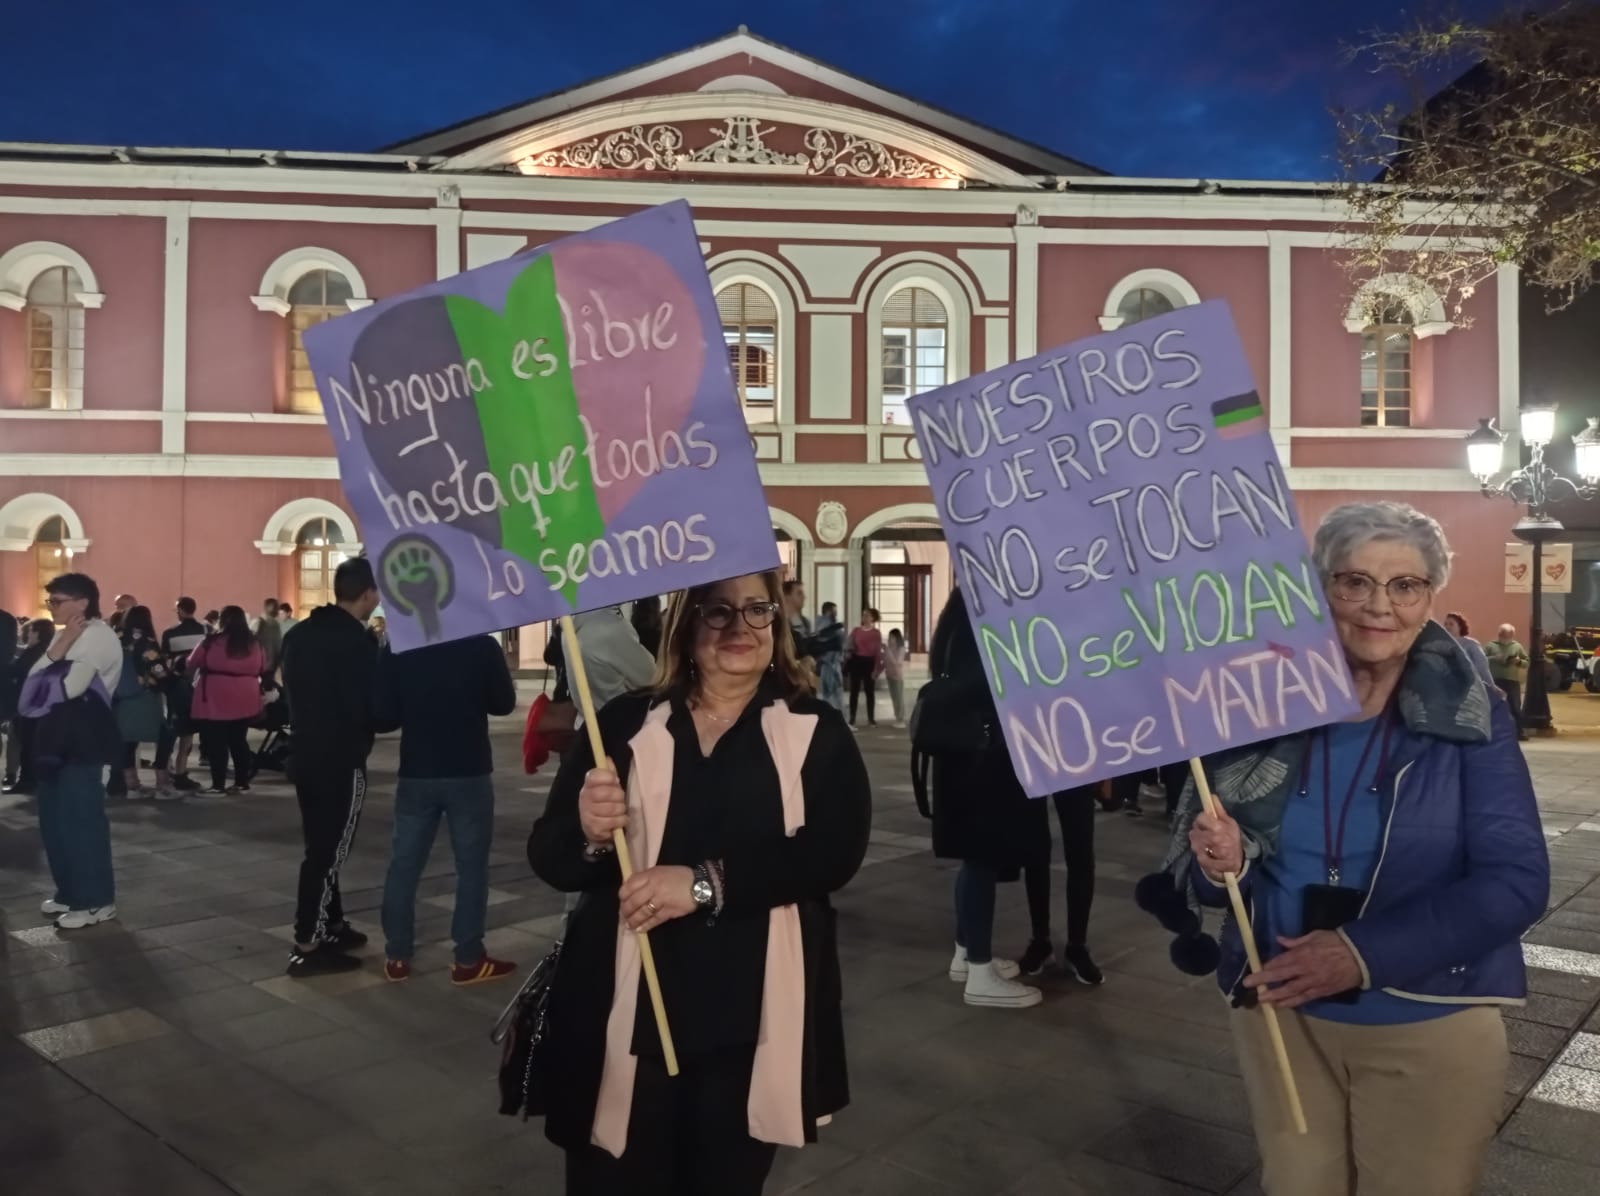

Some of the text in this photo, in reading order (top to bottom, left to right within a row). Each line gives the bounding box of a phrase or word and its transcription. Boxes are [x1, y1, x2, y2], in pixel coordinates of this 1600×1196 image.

[329, 360, 494, 456] Ninguna
[512, 337, 558, 380] es
[916, 329, 1201, 466] NUESTROS
[370, 385, 718, 541] hasta que todas
[946, 403, 1206, 525] CUERPOS
[473, 514, 716, 601] Lo seamos
[957, 461, 1295, 617] NO se TOCAN
[981, 558, 1323, 698] NO se VIOLAN
[1008, 697, 1097, 787] NO
[1102, 715, 1161, 764] se
